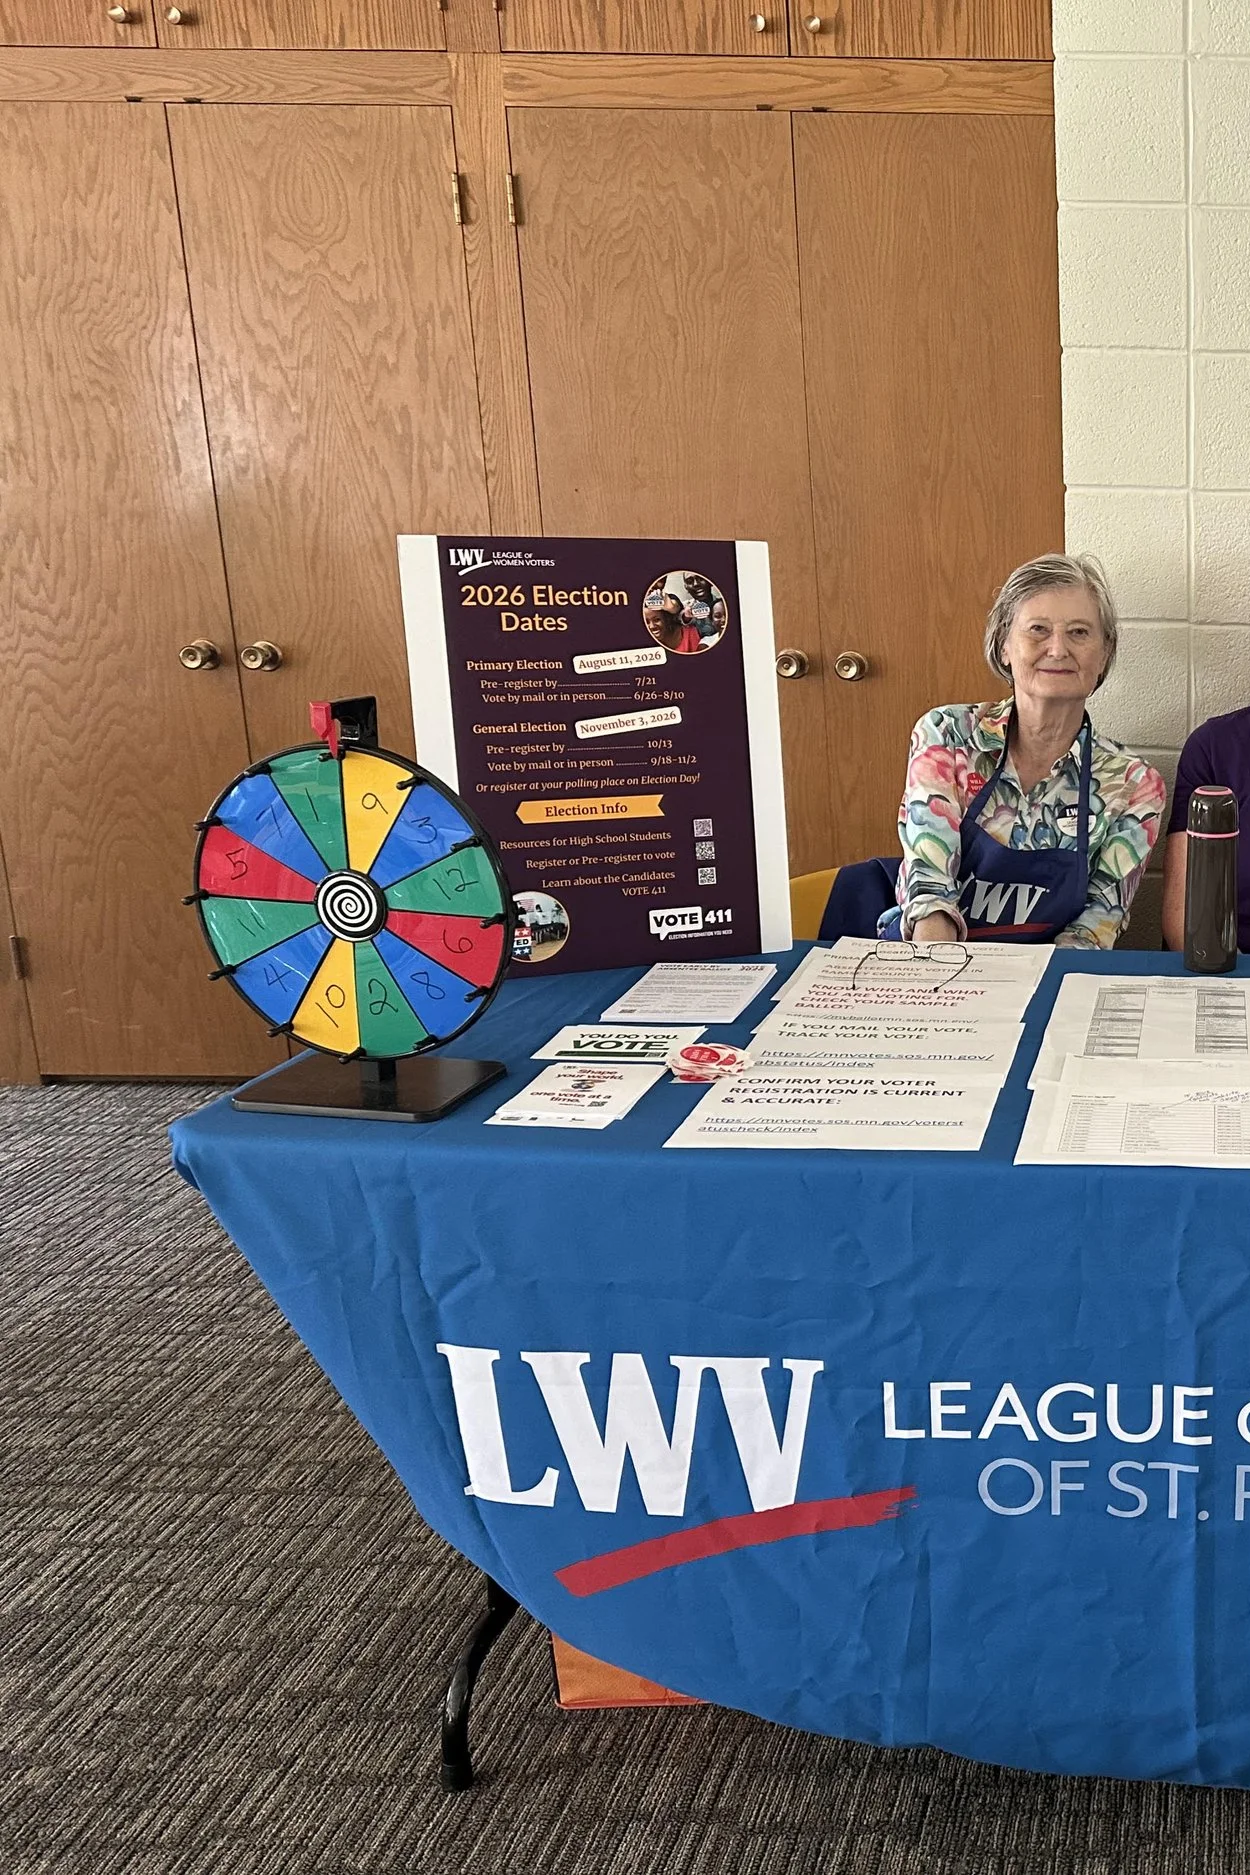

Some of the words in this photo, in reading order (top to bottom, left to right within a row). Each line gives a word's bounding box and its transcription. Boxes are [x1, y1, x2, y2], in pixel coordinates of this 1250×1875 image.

[449, 548, 485, 566] LWV
[525, 559, 555, 567] VOTERS
[461, 584, 525, 606] 2026
[532, 585, 628, 606] Election
[501, 612, 568, 632] Dates
[466, 660, 514, 673] Primary
[517, 659, 563, 670] Election
[578, 656, 617, 671] August
[619, 655, 633, 667] 11,
[635, 651, 662, 663] 2026
[480, 679, 543, 691] Pre-register
[635, 677, 656, 687] 7/21
[482, 694, 505, 704] Vote
[507, 693, 520, 704] by
[522, 692, 545, 702] mail
[547, 694, 558, 702] or
[560, 692, 570, 701] in
[634, 691, 685, 701] 6/26-8/10
[472, 723, 518, 735] General
[520, 722, 567, 733] Election
[580, 718, 637, 734] November
[639, 716, 649, 727] 3,
[650, 711, 676, 724] 2026
[486, 743, 550, 756] Pre-register
[552, 742, 565, 754] by
[647, 739, 673, 750] 10/13
[487, 762, 511, 772] Vote
[513, 761, 526, 773] by
[528, 759, 551, 770] mail
[553, 761, 565, 769] or
[567, 759, 577, 769] in
[579, 758, 614, 770] person
[650, 755, 697, 767] 9/18-11/2
[476, 782, 488, 792] Or
[490, 781, 527, 793] register
[529, 782, 539, 790] at
[541, 780, 563, 791] your
[565, 778, 599, 791] polling
[600, 777, 625, 789] place
[626, 778, 639, 786] on
[641, 774, 678, 785] Election
[680, 773, 700, 785] Day!
[306, 788, 319, 822] 1
[361, 792, 388, 815] 9
[545, 804, 598, 817] Election
[601, 803, 628, 815] Info
[411, 817, 437, 844] 3
[499, 838, 550, 850] Resources
[552, 837, 568, 847] for
[569, 836, 594, 848] High
[595, 833, 627, 844] School
[629, 831, 672, 842] Students
[225, 848, 248, 880] 5
[526, 857, 567, 870] Register
[569, 857, 580, 865] or
[582, 853, 641, 867] Pre-register
[643, 852, 653, 860] to
[654, 850, 676, 859] vote
[435, 868, 479, 900] 12
[542, 878, 571, 889] Learn
[573, 875, 602, 887] about
[604, 874, 620, 884] the
[621, 870, 676, 882] Candidates
[622, 887, 650, 897] VOTE
[651, 885, 666, 896] 411
[653, 912, 699, 928] VOTE
[705, 908, 732, 924] 411
[264, 963, 291, 993] 4
[410, 971, 445, 1000] 8
[315, 984, 345, 1028] 10
[369, 978, 398, 1015] 2
[754, 1059, 875, 1068] abstatus/index
[760, 1050, 994, 1062] https://mnvotes.sos.mn.gov/
[729, 1087, 858, 1095] REGISTRATION
[883, 1089, 966, 1097] CURRENT
[741, 1097, 842, 1105] ACCURATE:
[698, 1125, 819, 1133] atuscheck/index
[883, 1381, 1214, 1446] LEAGUE
[436, 1342, 824, 1517] LWV
[977, 1457, 1091, 1517] OF
[1106, 1461, 1211, 1521] ST.
